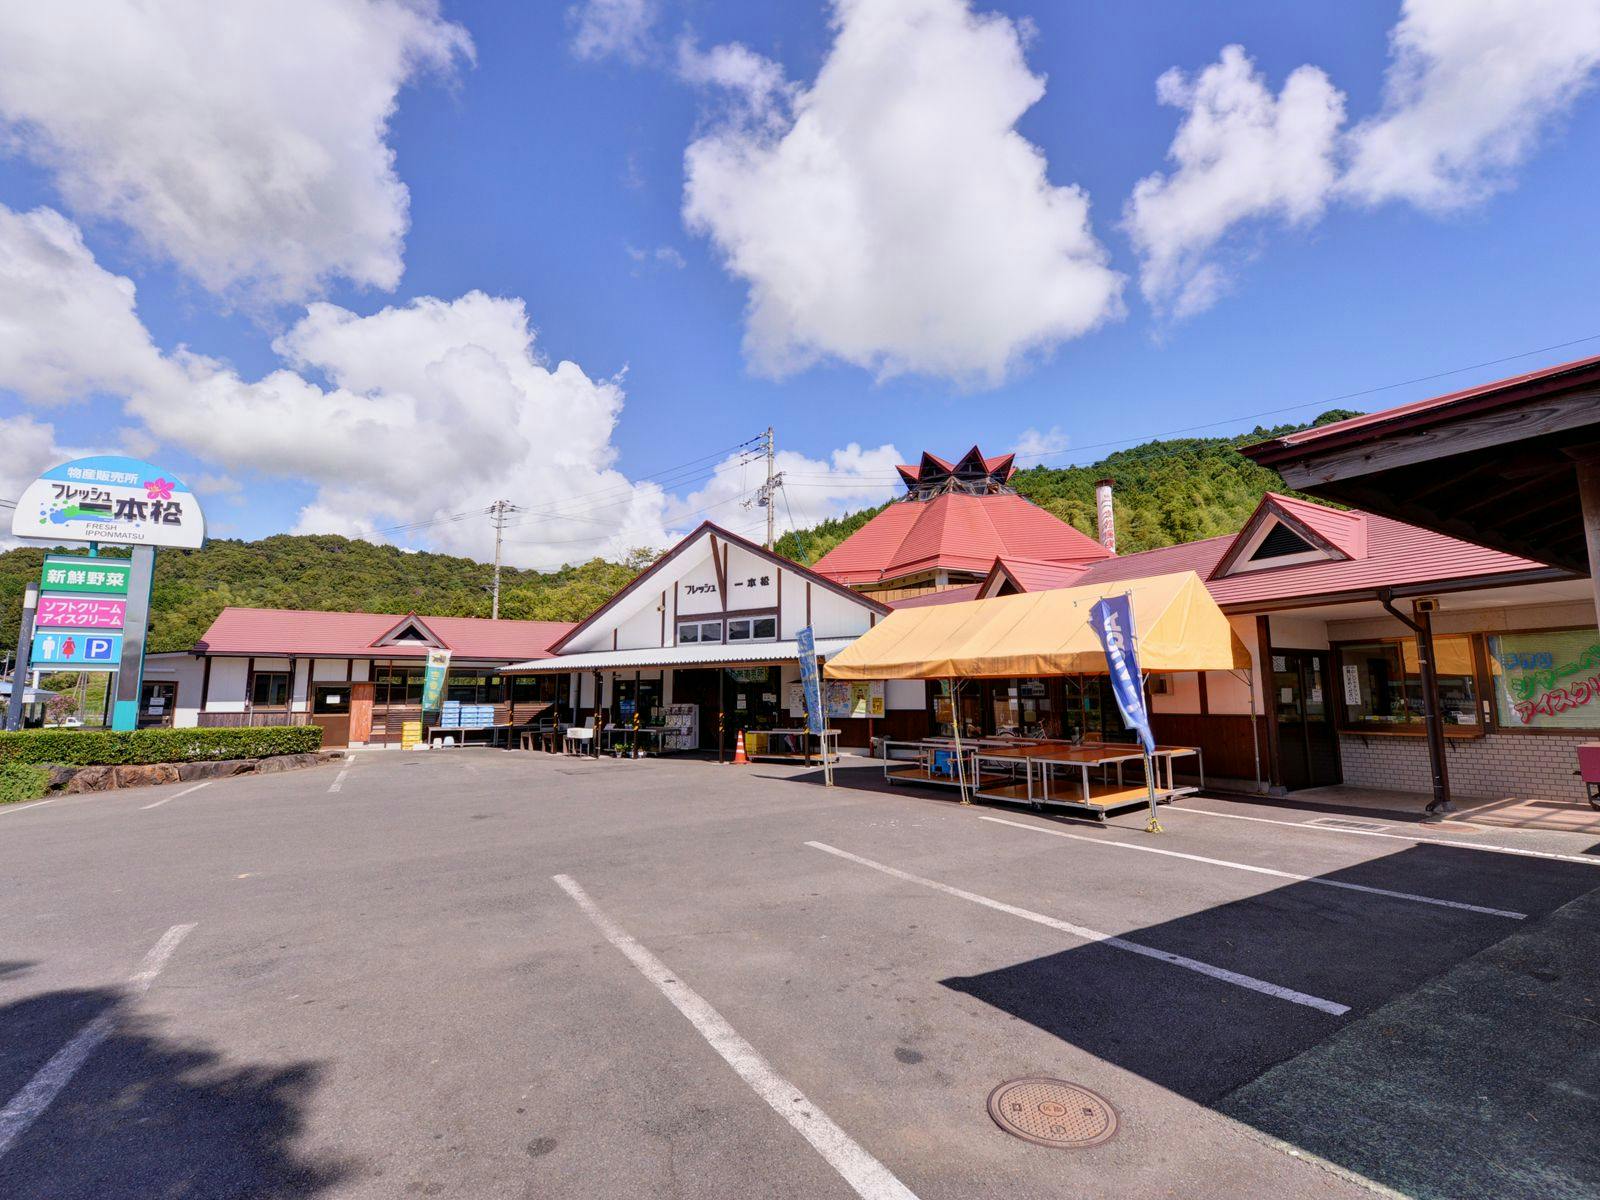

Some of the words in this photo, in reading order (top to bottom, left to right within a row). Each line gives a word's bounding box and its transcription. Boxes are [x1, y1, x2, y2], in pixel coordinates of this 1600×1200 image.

[68, 467, 139, 484] 物産販売所
[51, 484, 112, 501] フレッシュ
[79, 498, 183, 525] 一本松
[85, 530, 145, 540] IPPONMATSU
[86, 522, 117, 531] FRESH
[47, 569, 124, 587] 新鮮野菜
[684, 584, 717, 594] フレッシュ
[734, 576, 770, 587] 一本松
[45, 602, 121, 614] ソフトクリーム
[42, 613, 121, 626] アイスクリーム
[91, 640, 107, 657] P
